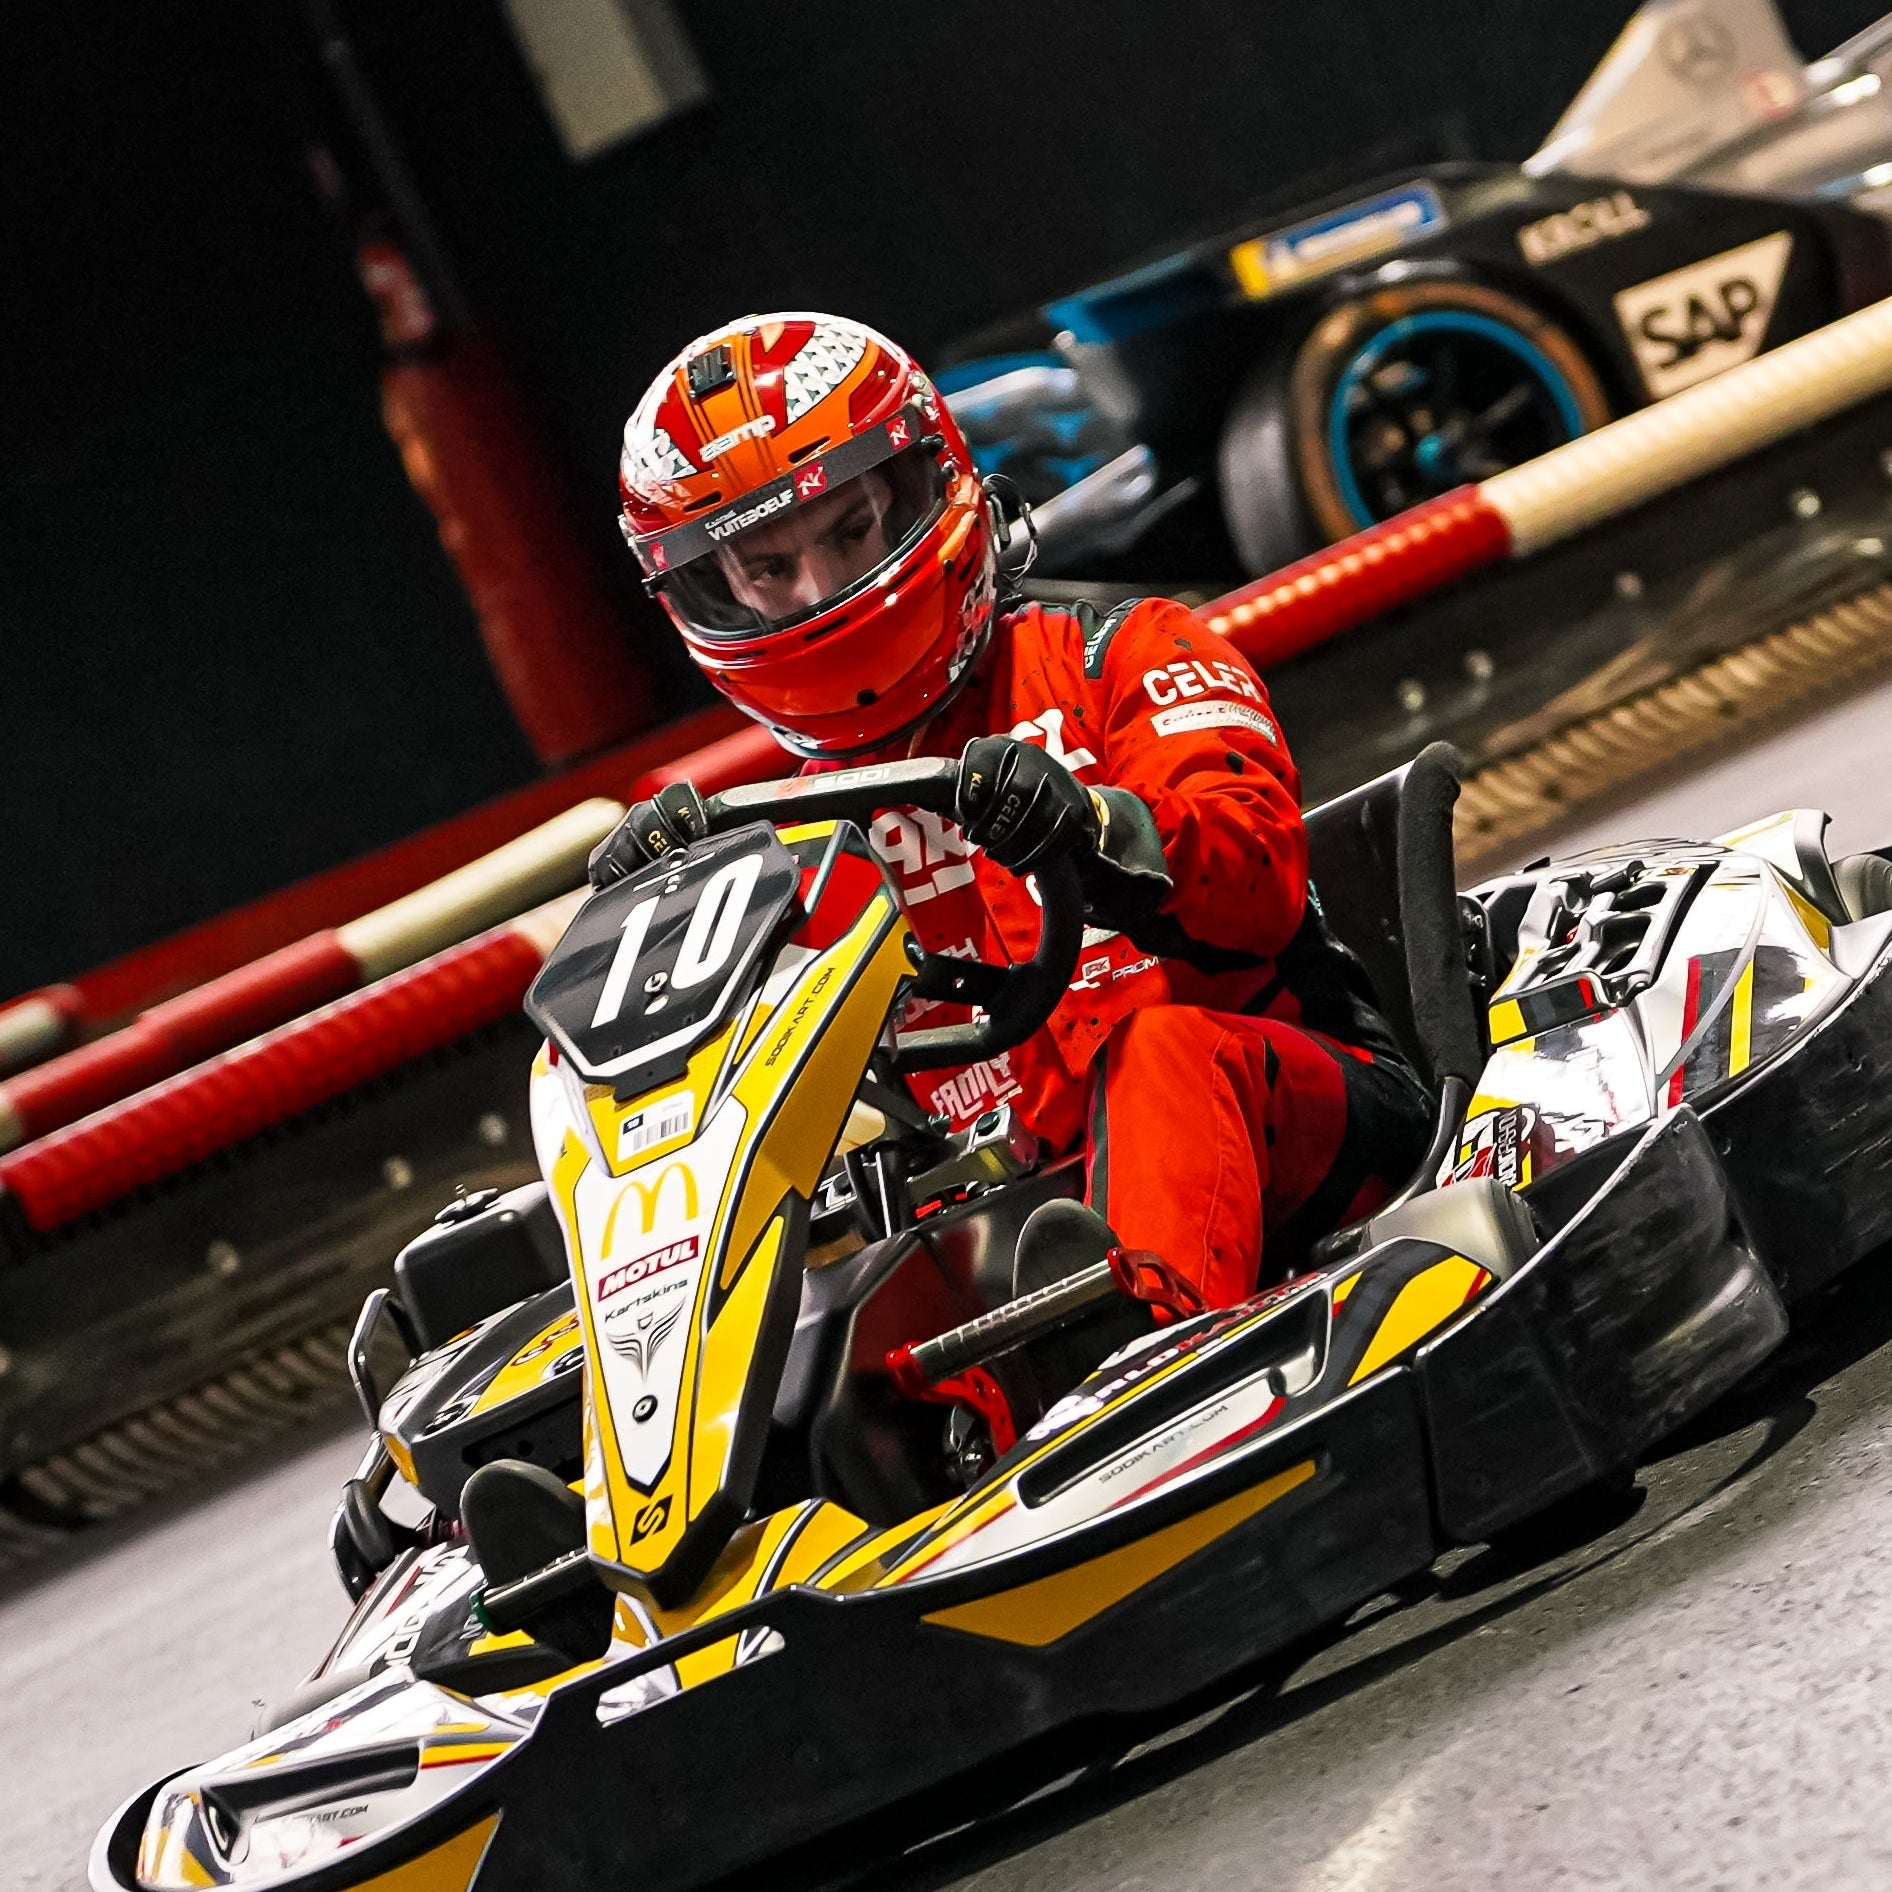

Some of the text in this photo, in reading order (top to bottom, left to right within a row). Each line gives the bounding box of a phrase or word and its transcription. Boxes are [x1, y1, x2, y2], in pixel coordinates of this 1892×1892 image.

[1641, 279, 1757, 370] SAP
[813, 768, 891, 799] SODI
[590, 853, 763, 1028] 10
[601, 1243, 696, 1300] MOTUL
